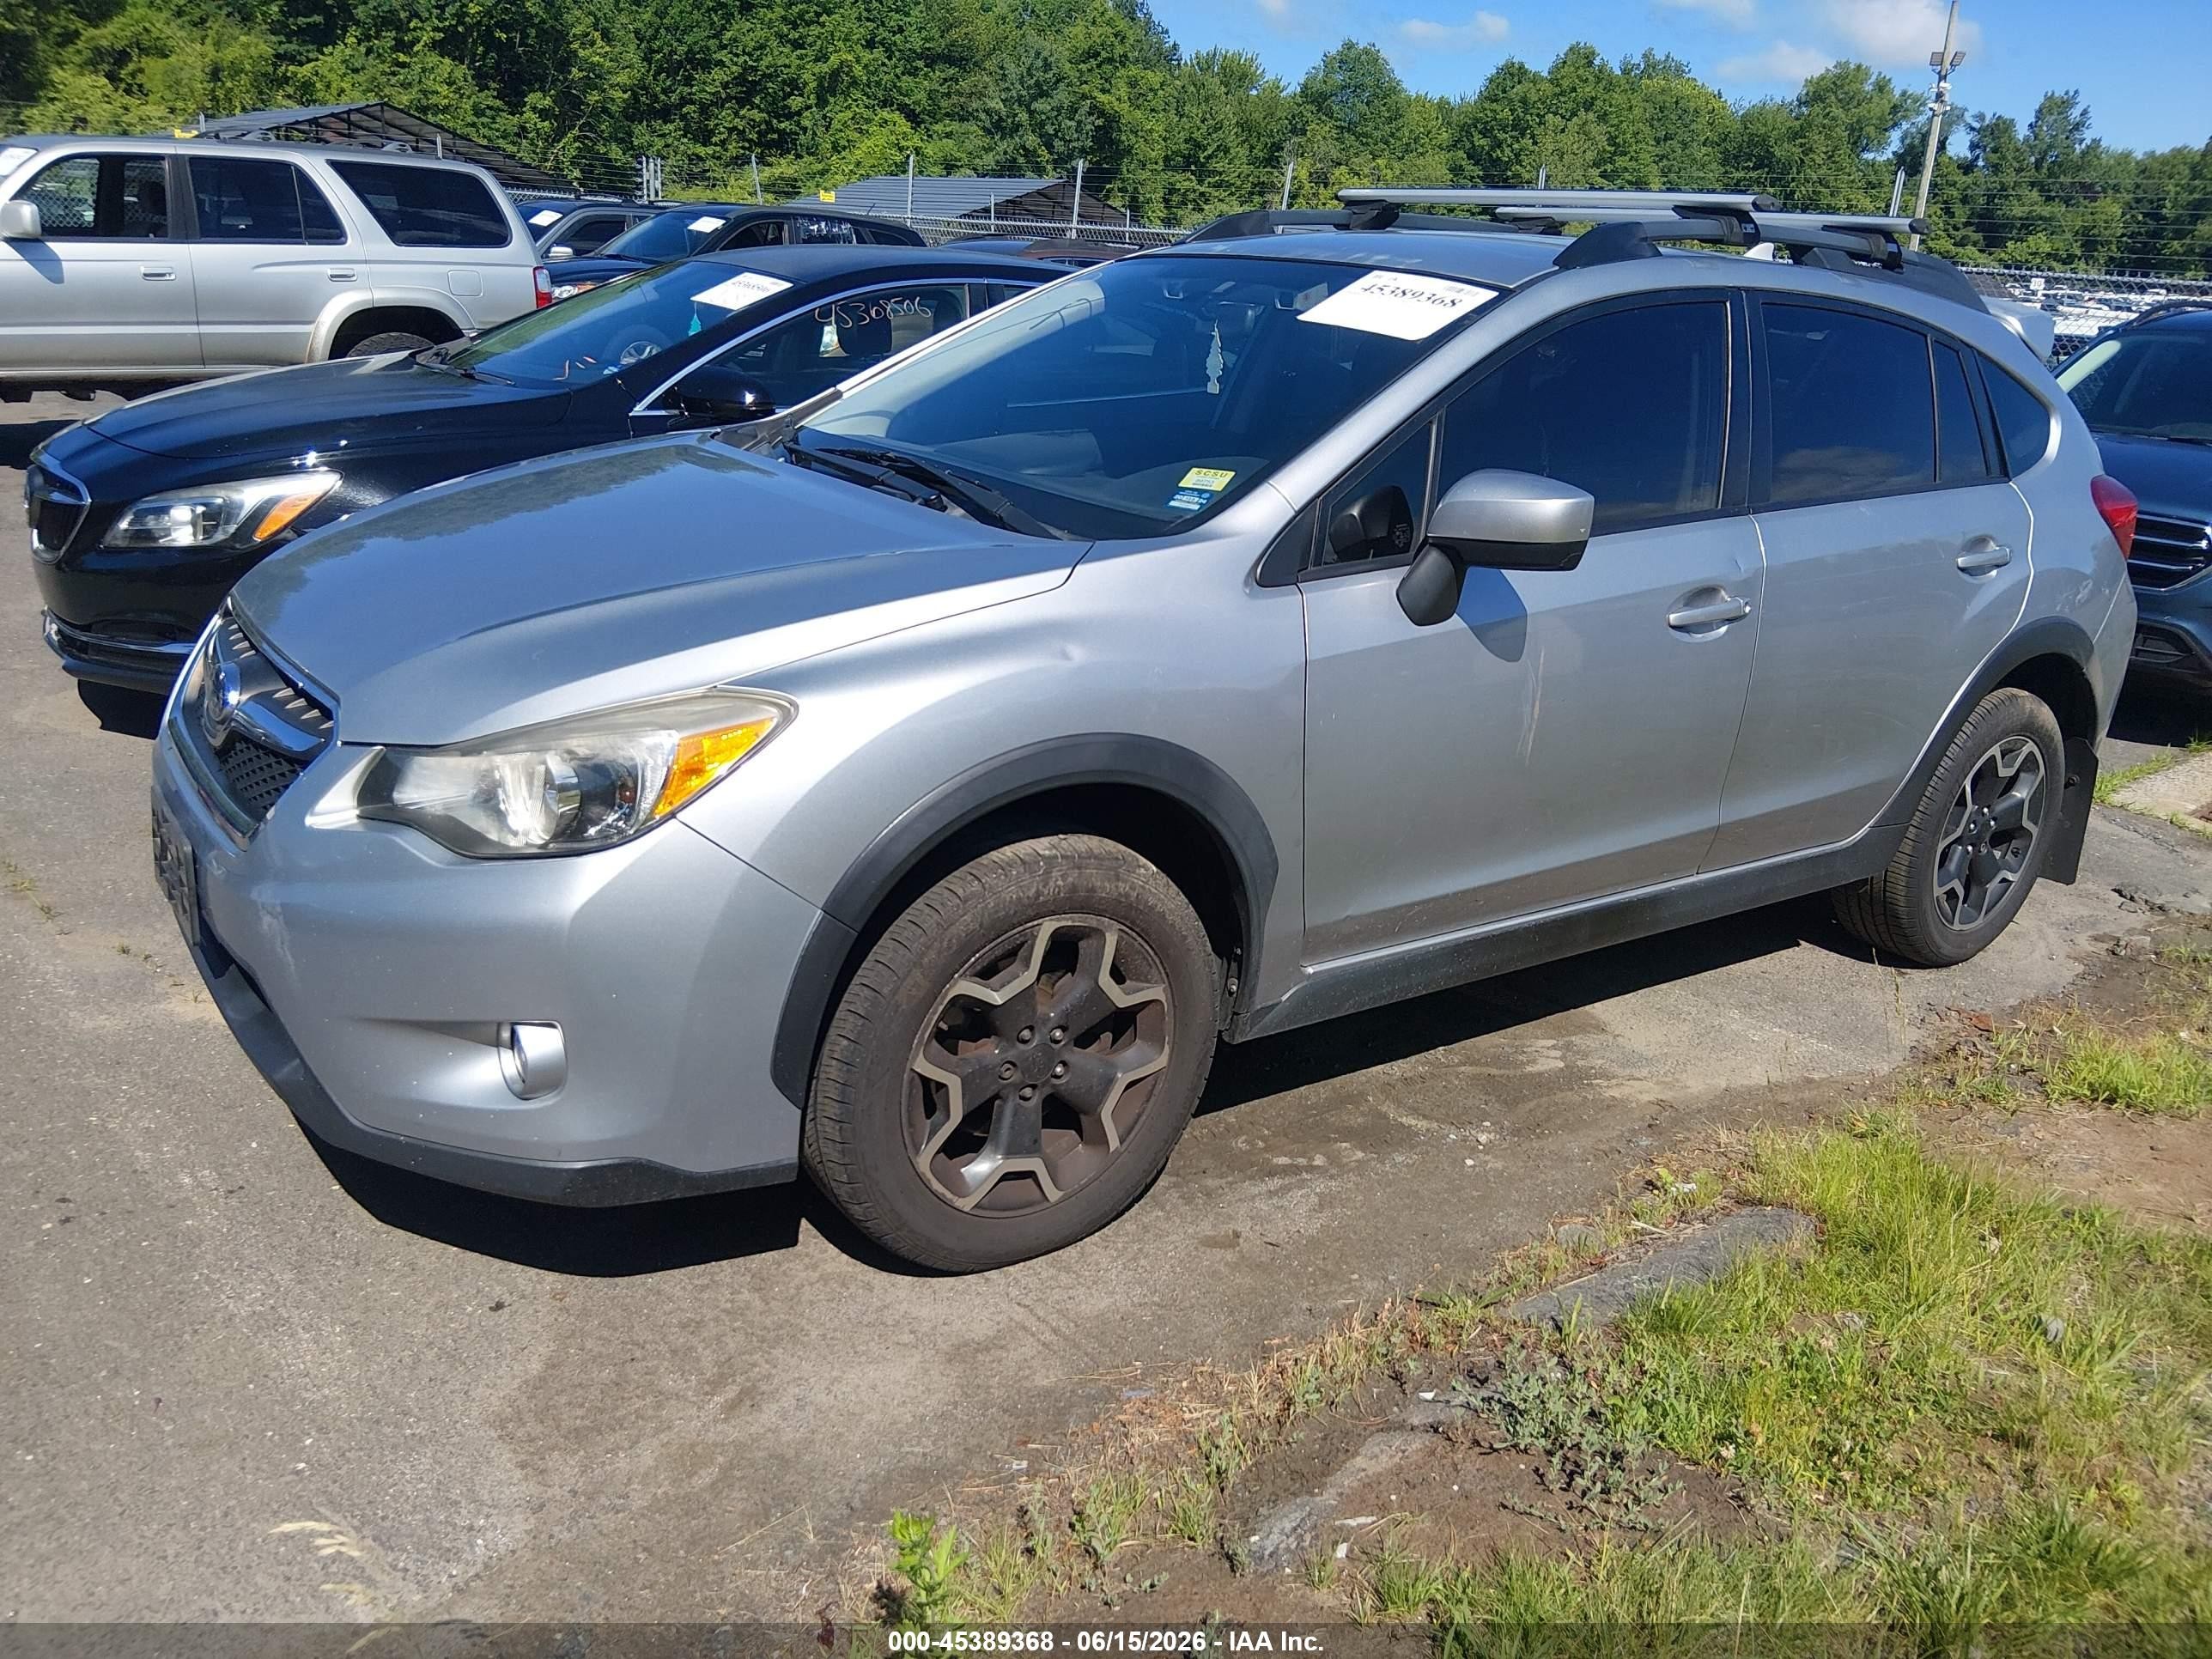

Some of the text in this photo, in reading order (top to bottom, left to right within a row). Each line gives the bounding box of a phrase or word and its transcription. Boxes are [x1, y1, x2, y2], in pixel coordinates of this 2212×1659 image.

[1361, 283, 1462, 307] 45389368
[813, 295, 933, 328] 45368506
[1194, 469, 1229, 478] SCSU
